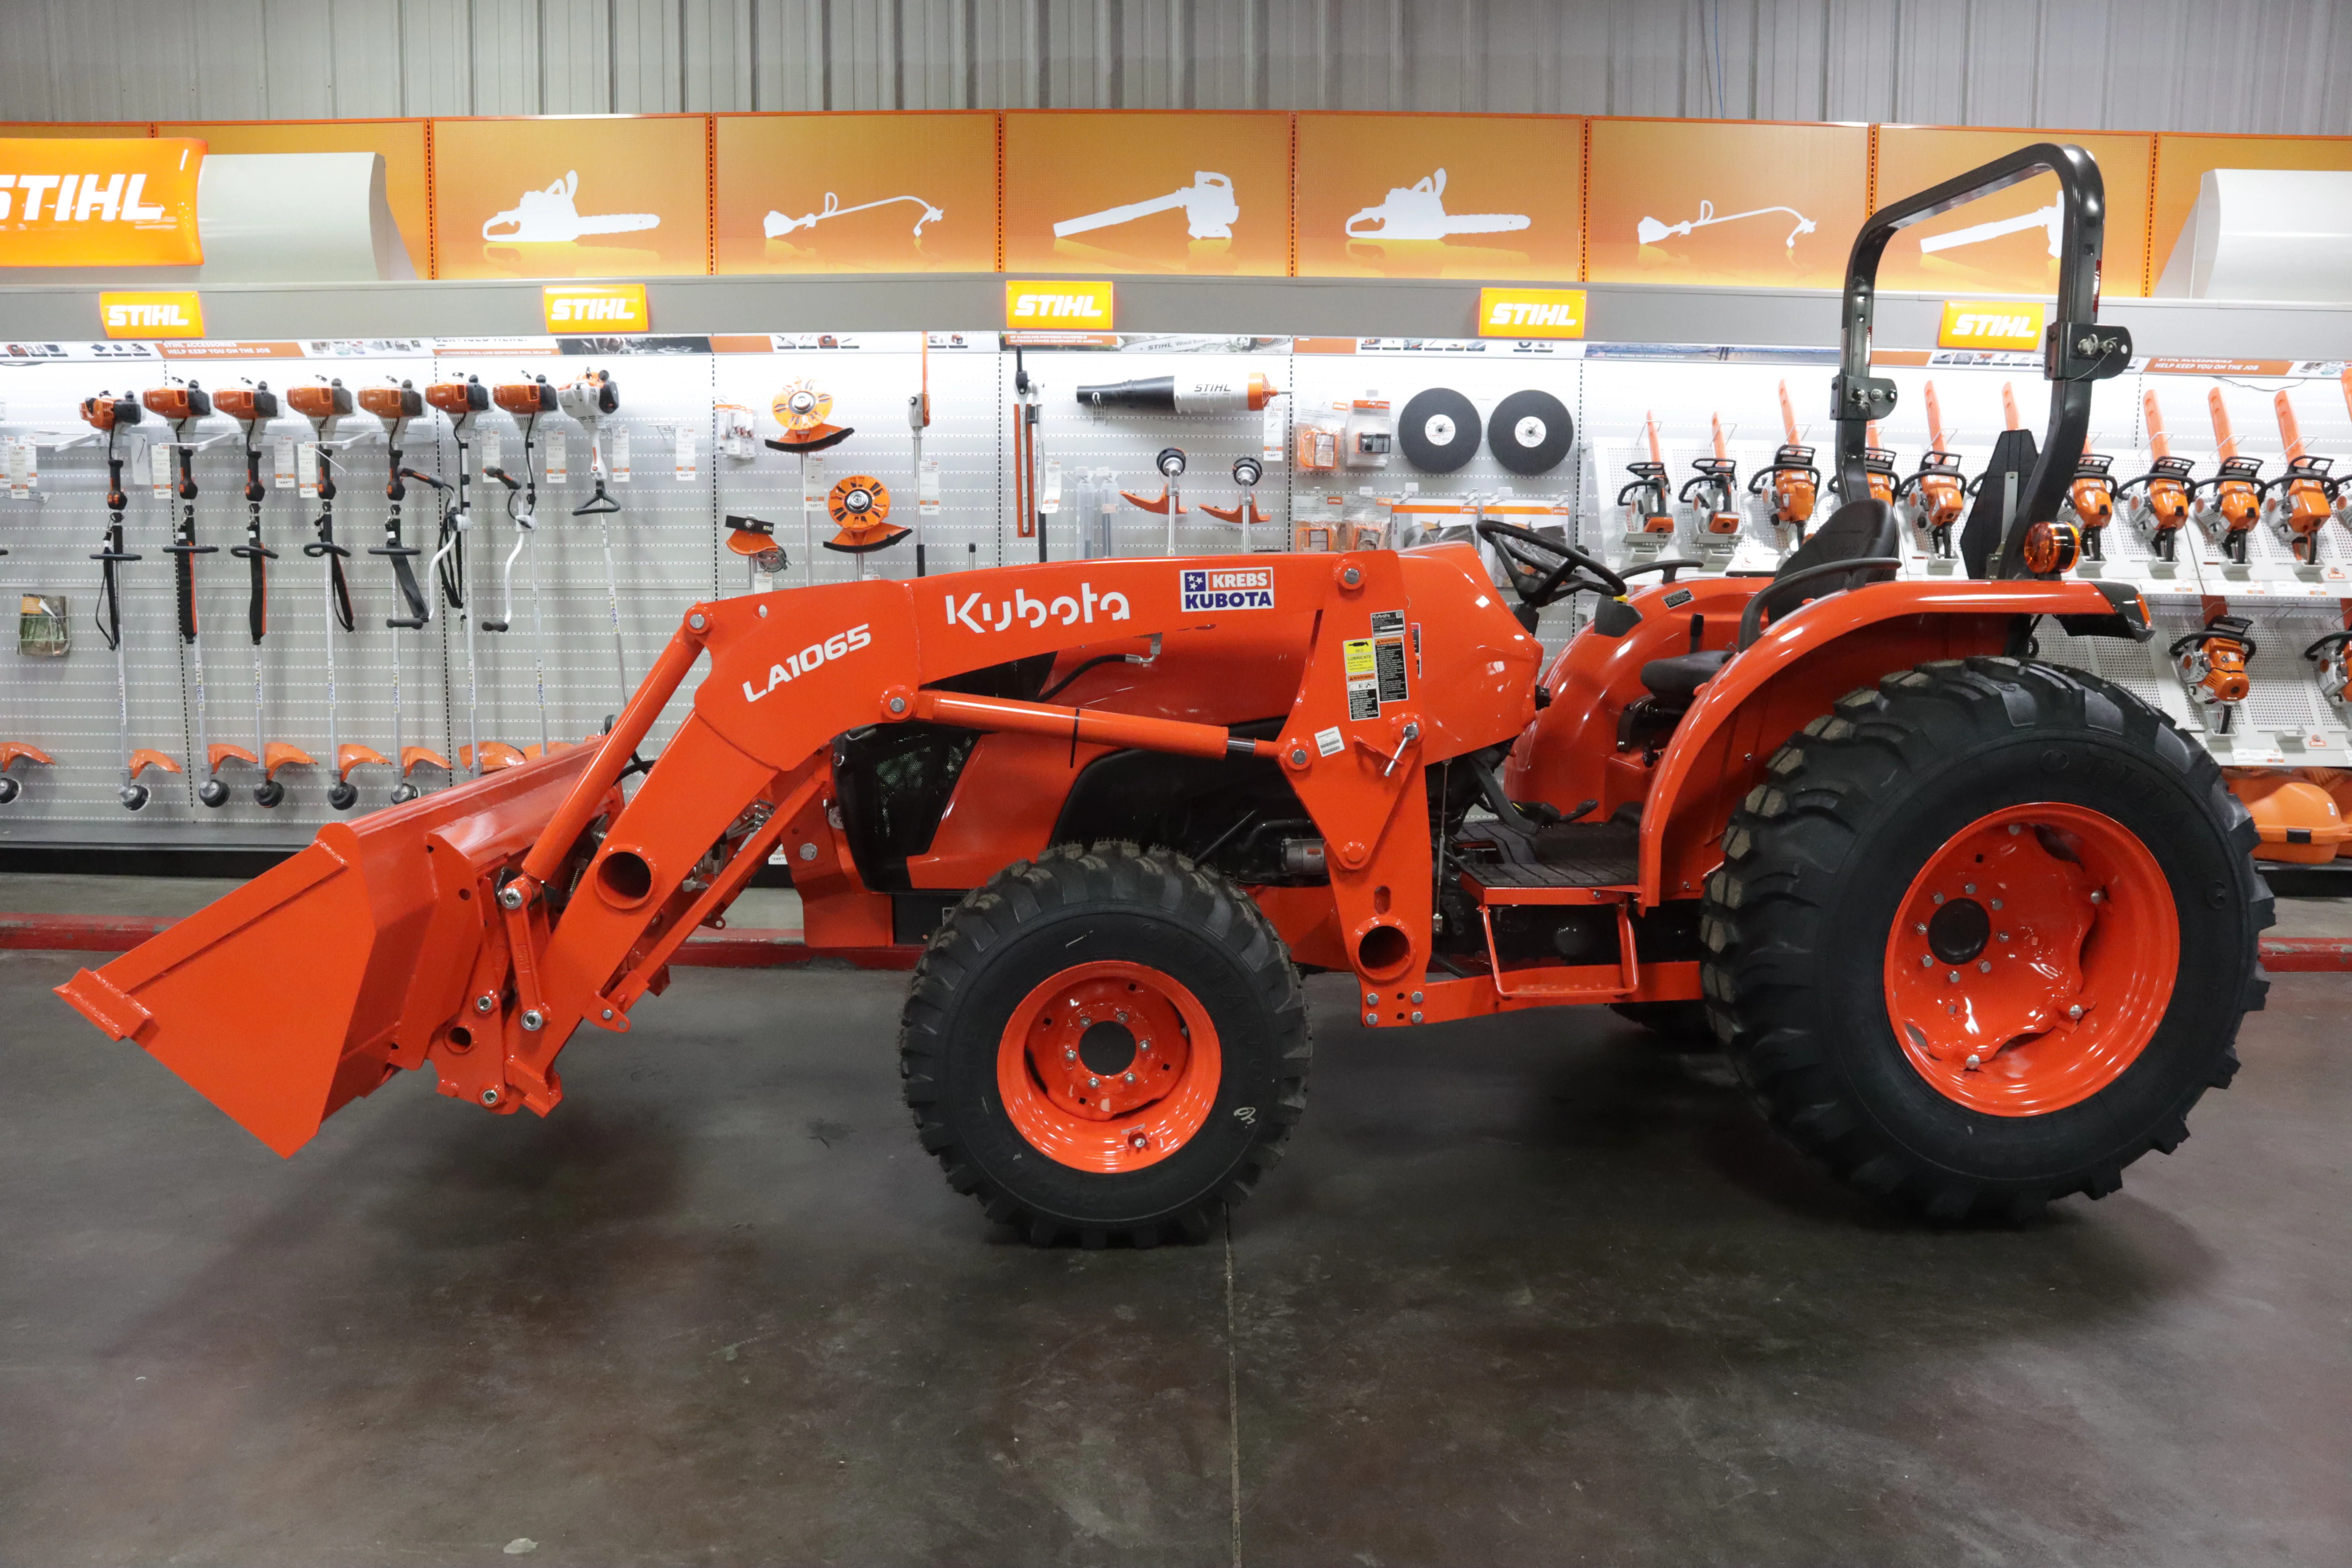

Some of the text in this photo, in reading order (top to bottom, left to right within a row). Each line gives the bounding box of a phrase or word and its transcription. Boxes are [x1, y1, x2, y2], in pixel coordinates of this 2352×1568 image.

[108, 305, 188, 325] STIHL
[551, 298, 635, 320] STIHL
[1014, 295, 1102, 316] STIHL
[1490, 303, 1576, 325] STIHL
[1952, 314, 2036, 338] STIHL
[1212, 572, 1268, 589] KREBS
[945, 583, 1131, 633] Kubota
[1185, 591, 1272, 610] KUBOTA
[742, 623, 871, 702] LA1065
